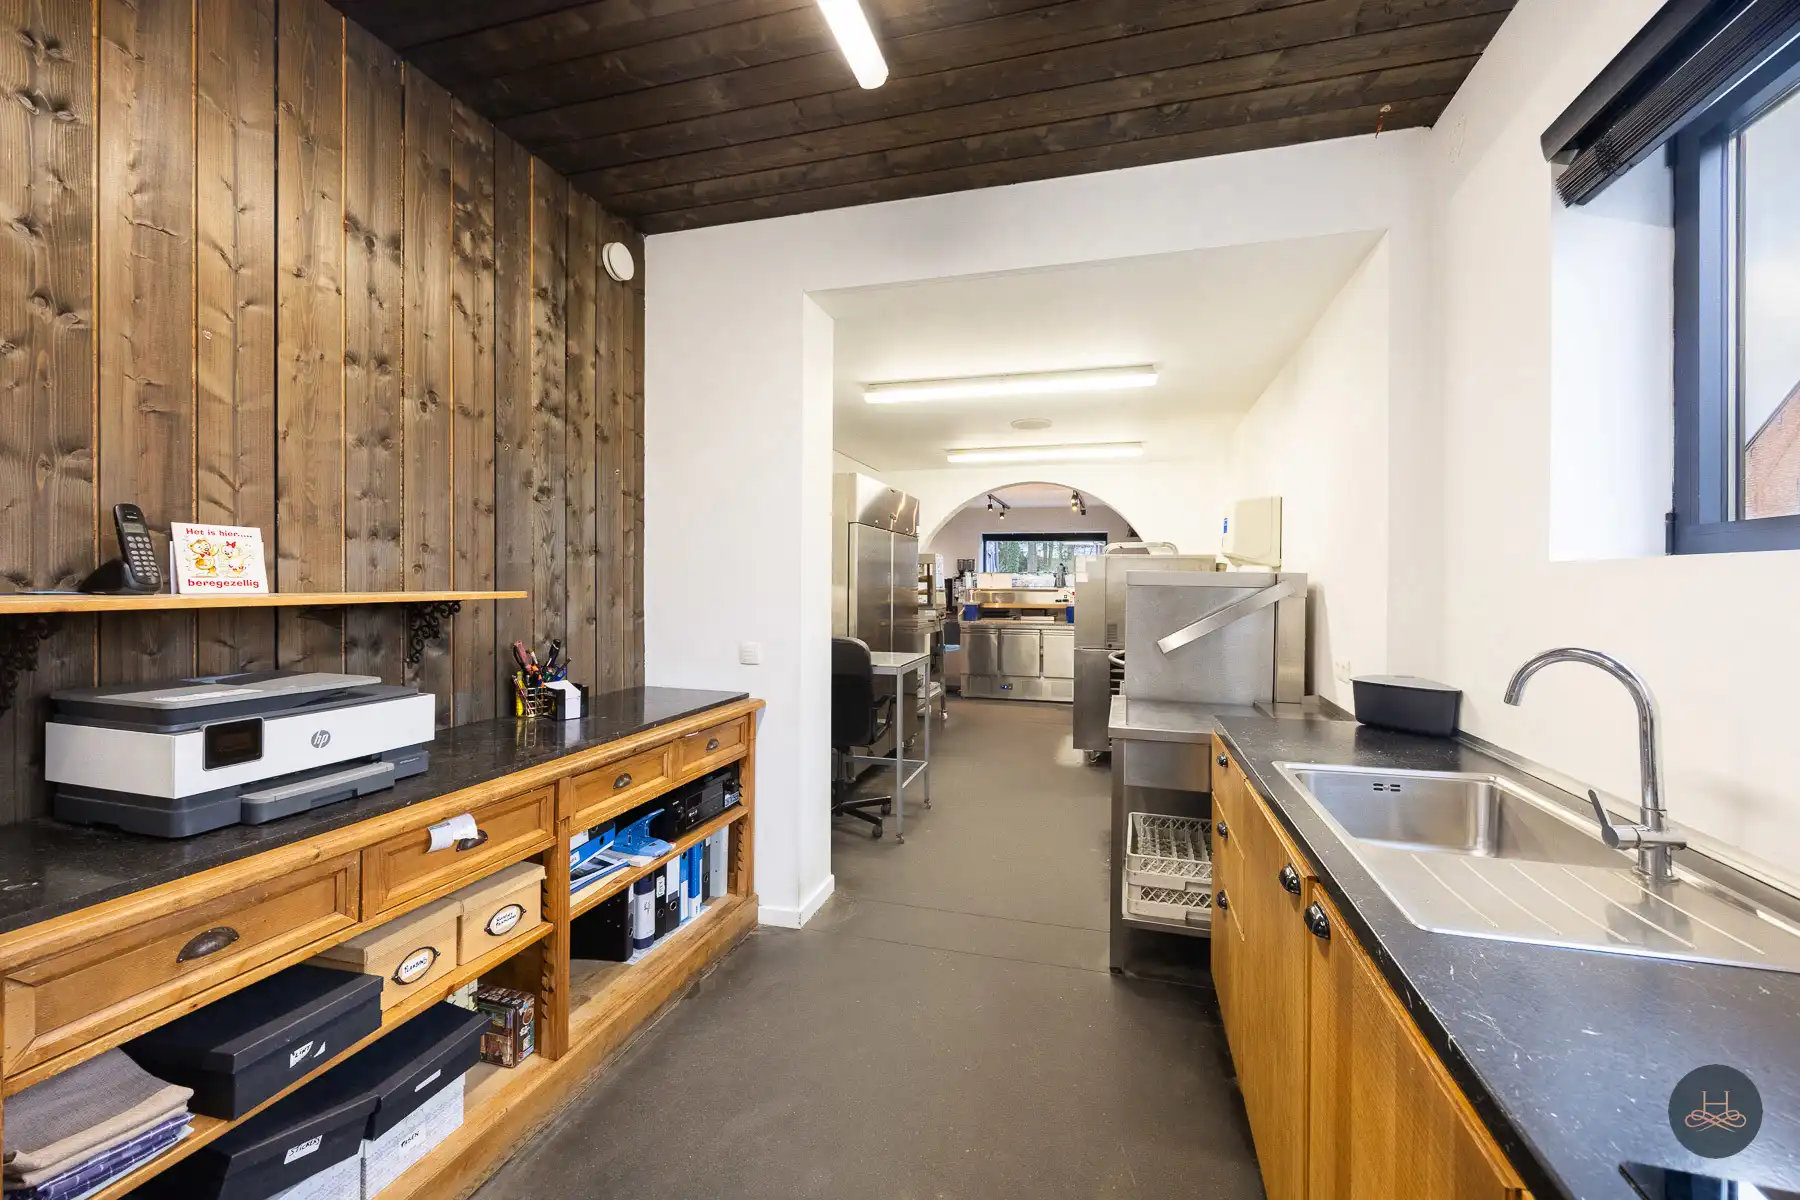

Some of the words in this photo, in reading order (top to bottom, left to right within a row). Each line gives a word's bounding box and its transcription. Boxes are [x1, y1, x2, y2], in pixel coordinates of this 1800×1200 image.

[186, 528, 204, 536] Het
[188, 579, 260, 588] beregezellig
[312, 729, 329, 748] hp
[288, 1136, 320, 1156] STICKERS
